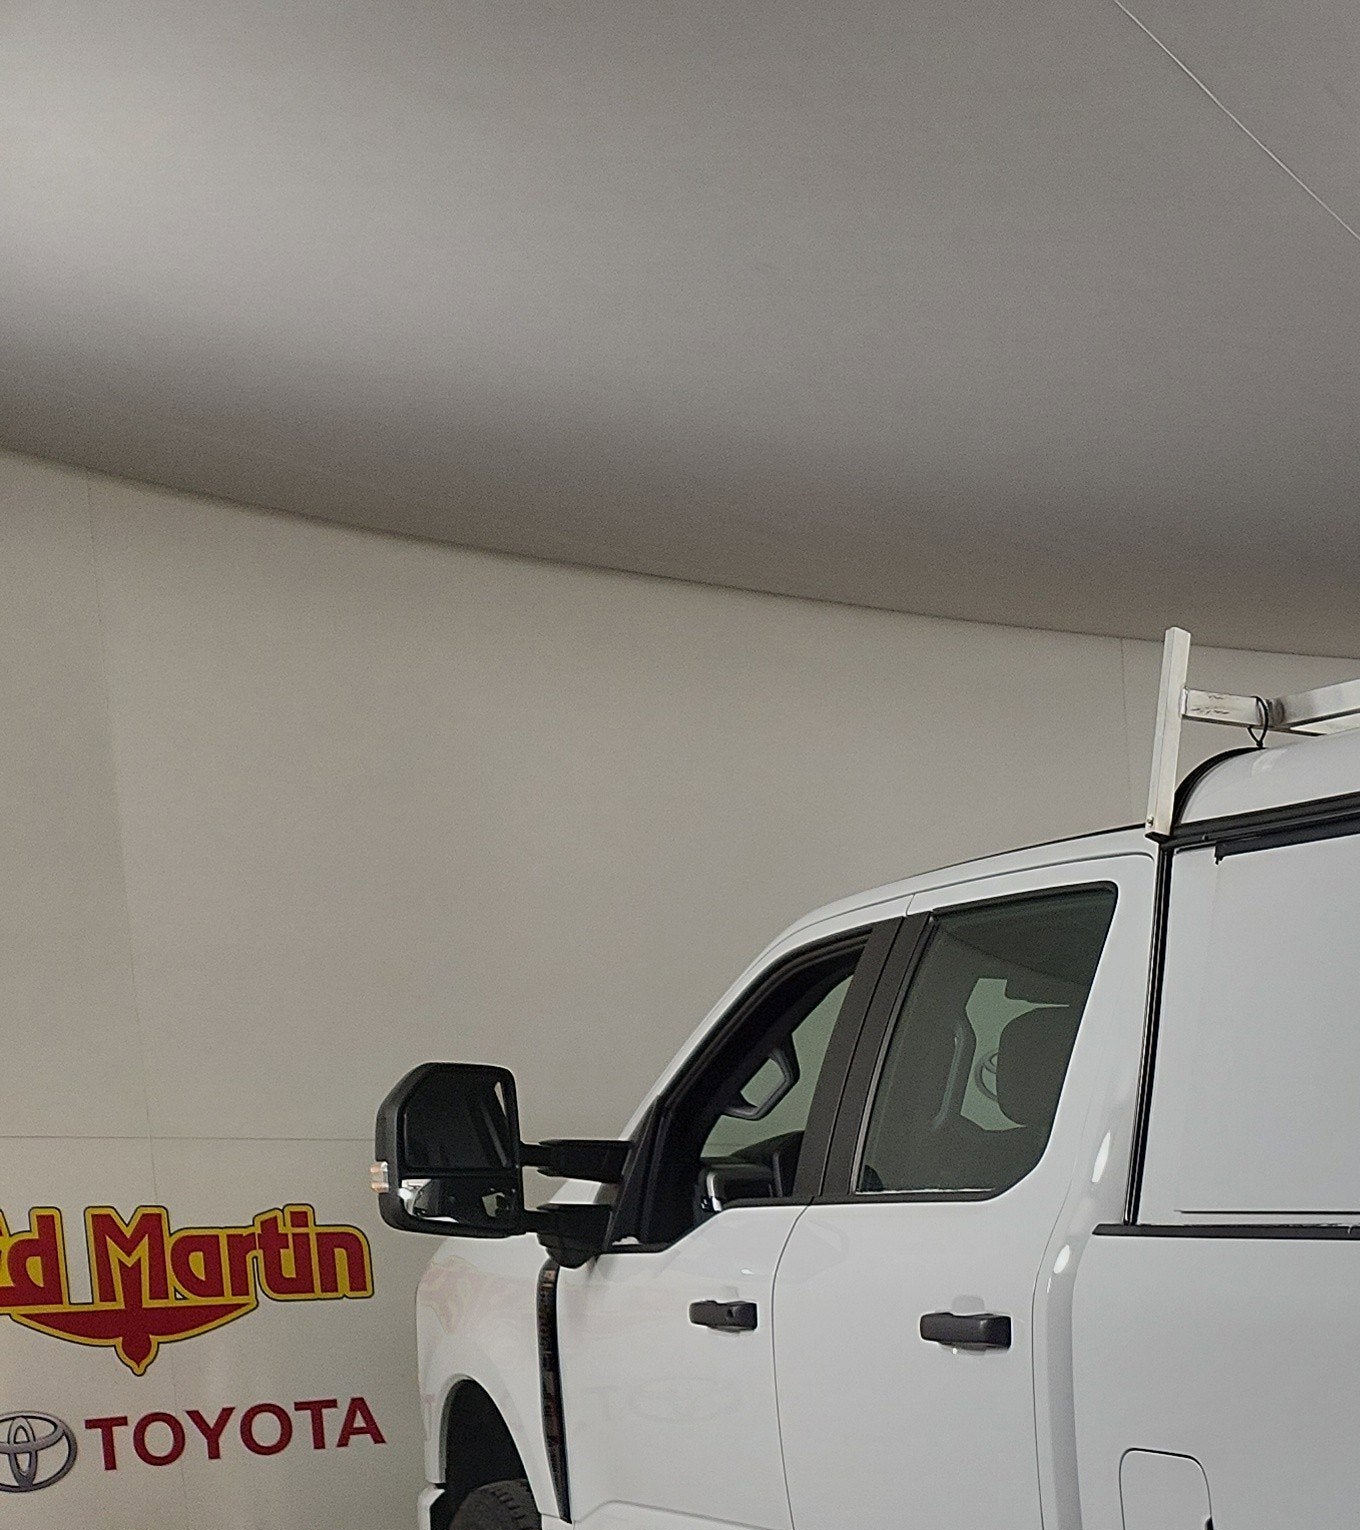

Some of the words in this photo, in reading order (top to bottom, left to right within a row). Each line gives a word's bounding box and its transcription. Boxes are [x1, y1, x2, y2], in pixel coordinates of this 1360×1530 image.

[0, 1209, 65, 1307] d
[88, 1207, 370, 1304] Martin
[84, 1397, 386, 1471] TOYOTA
